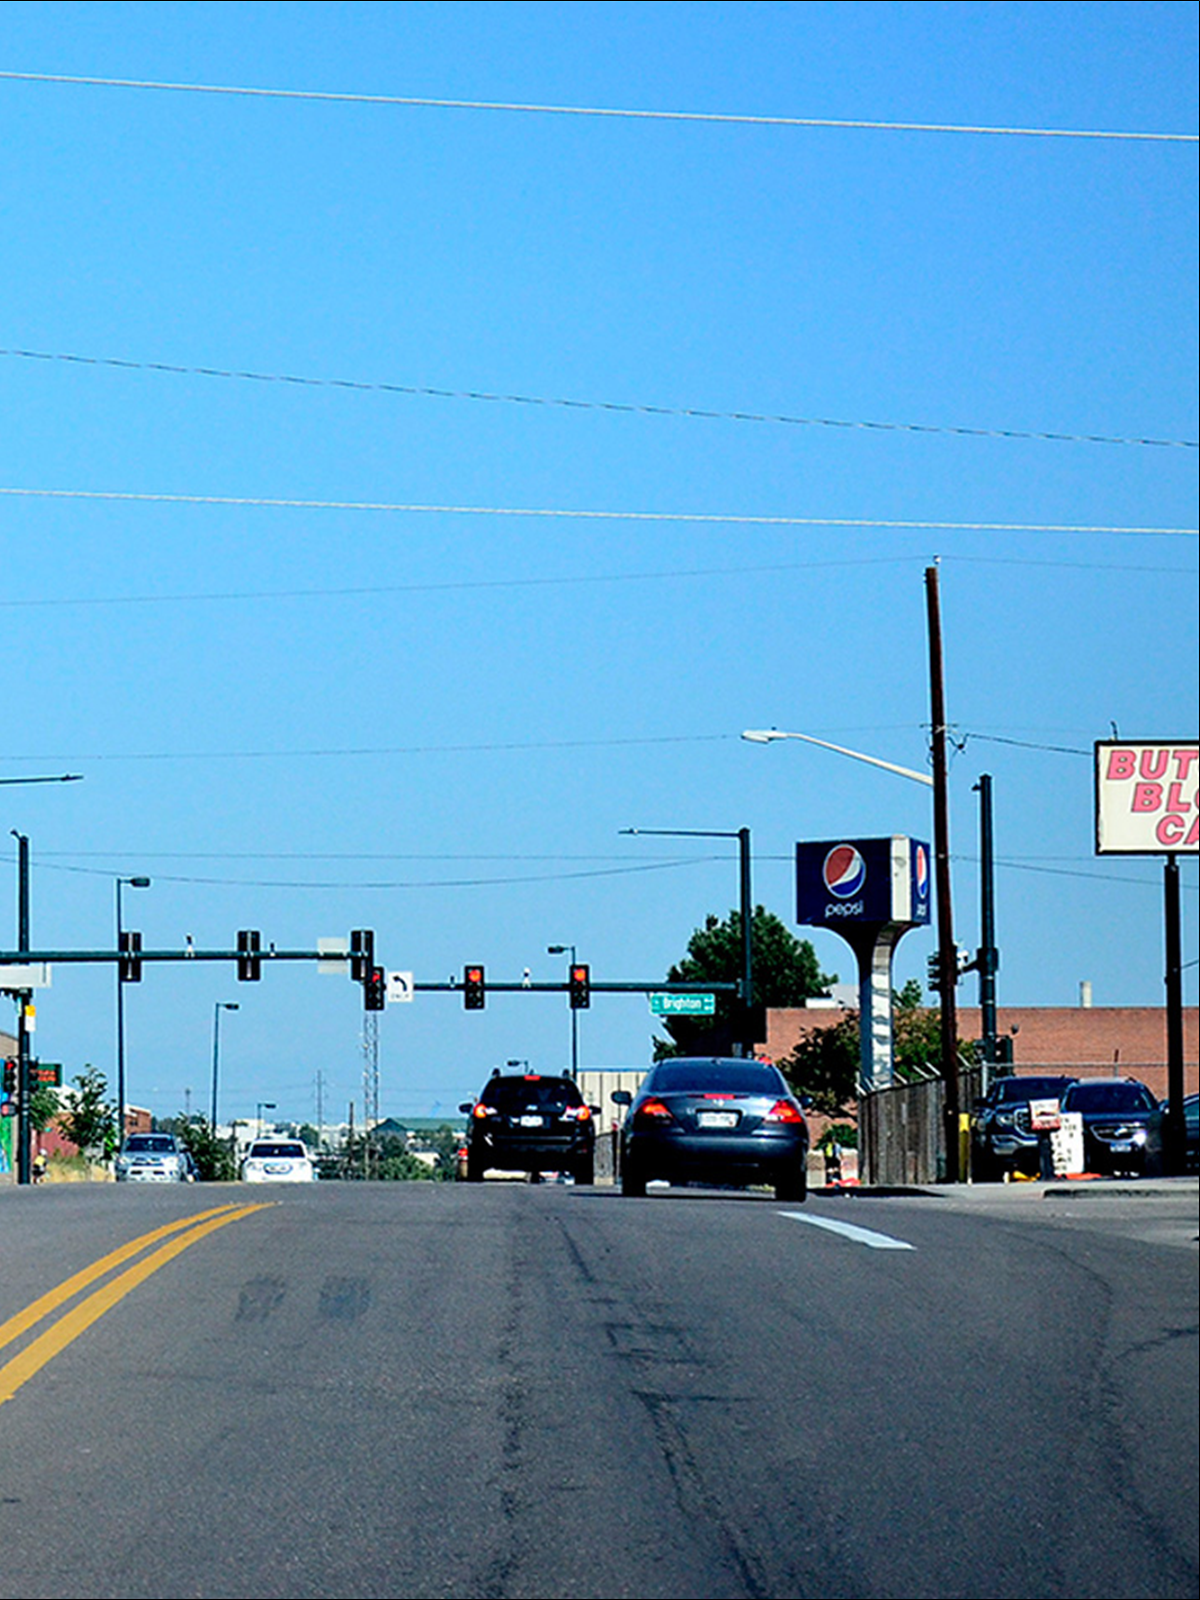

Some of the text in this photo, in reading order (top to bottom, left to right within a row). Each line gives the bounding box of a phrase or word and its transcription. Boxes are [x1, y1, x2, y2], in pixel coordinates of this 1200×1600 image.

[1131, 782, 1199, 813] BL
[825, 900, 863, 918] pepsi
[663, 996, 702, 1011] Brighton
